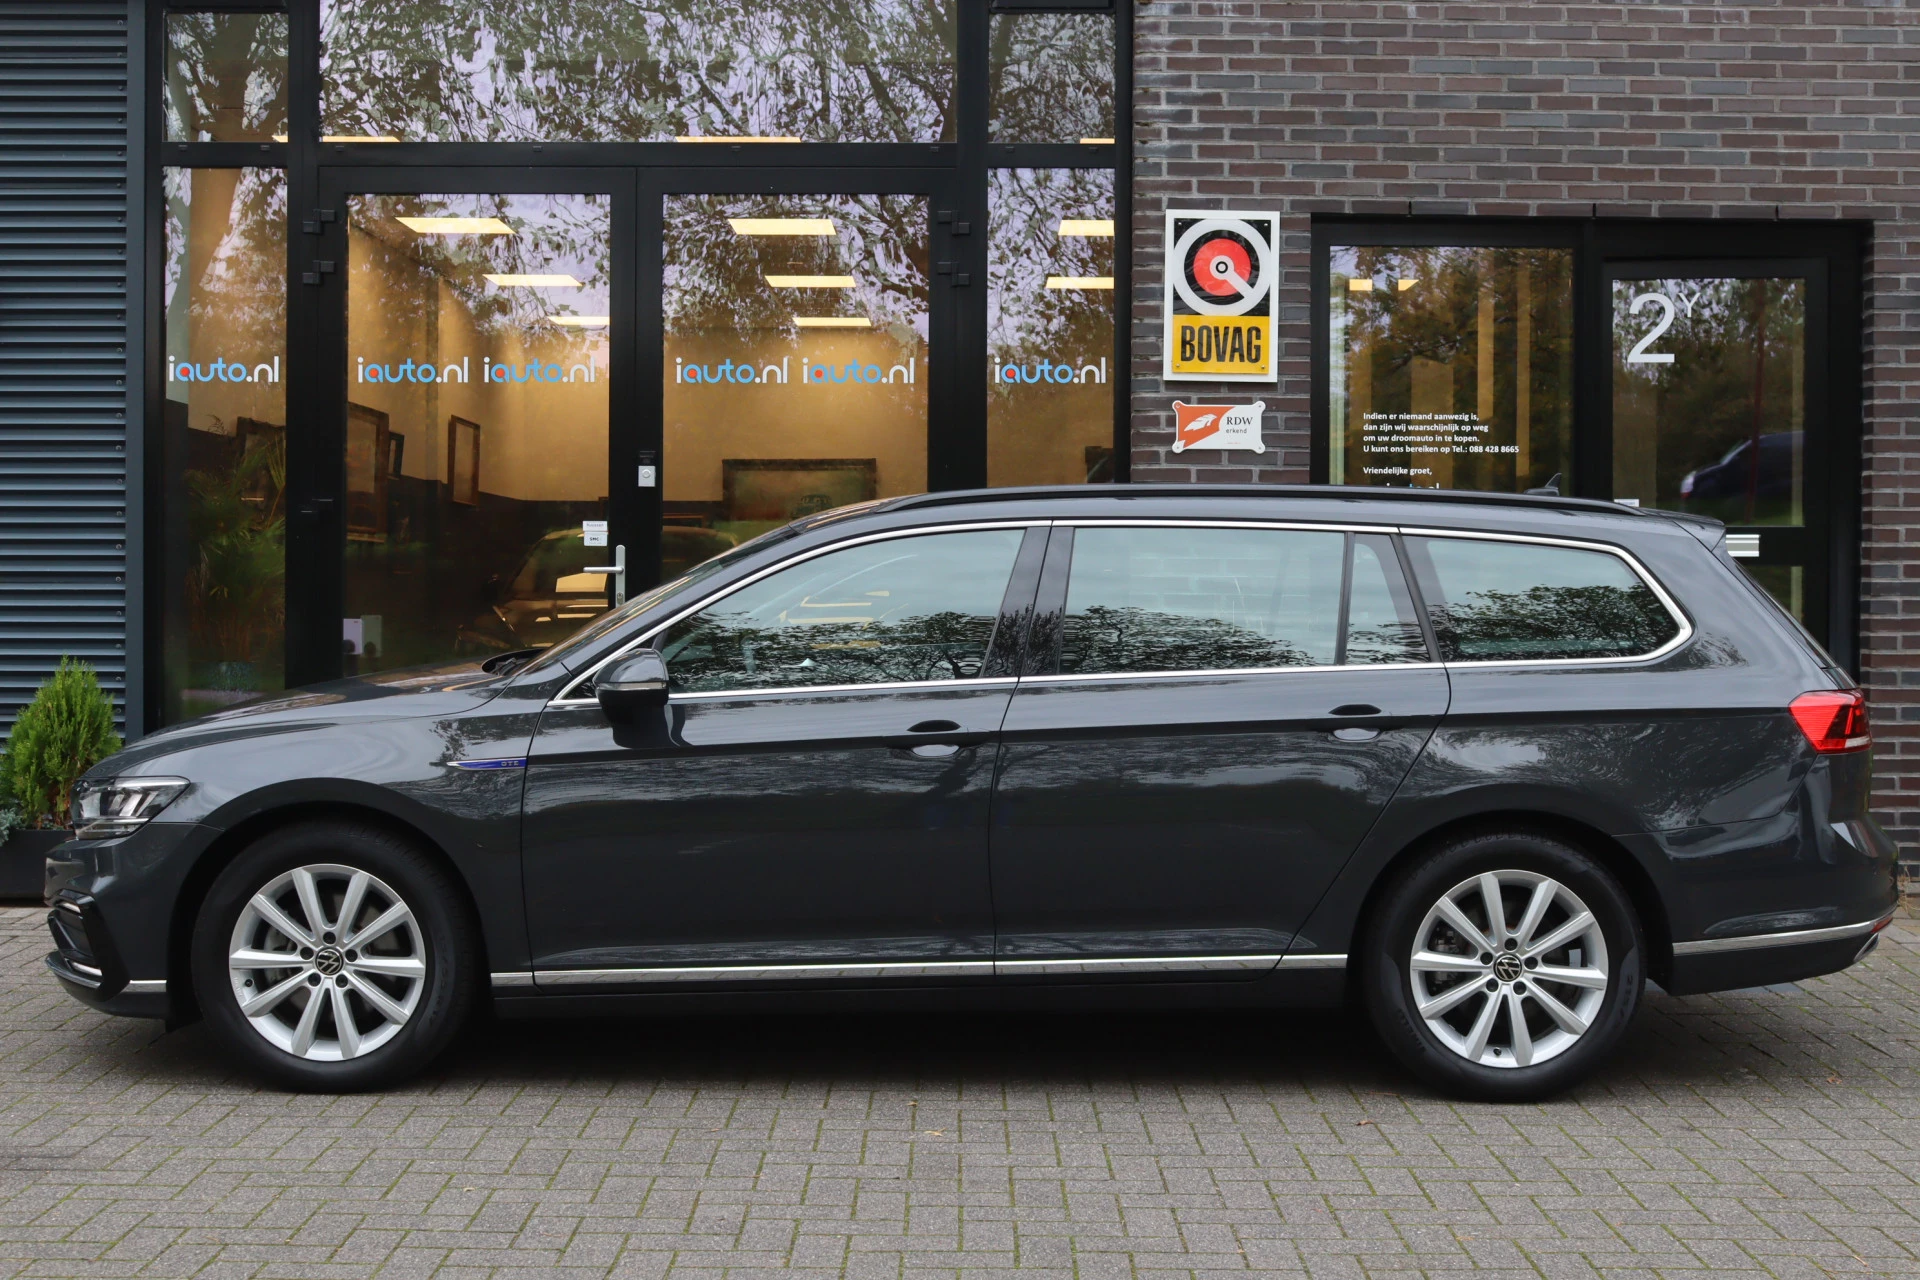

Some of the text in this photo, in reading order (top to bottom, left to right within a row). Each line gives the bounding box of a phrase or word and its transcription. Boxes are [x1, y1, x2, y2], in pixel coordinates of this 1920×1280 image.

[1180, 325, 1262, 363] BOVAG
[168, 355, 280, 383] iauto.nl
[357, 356, 596, 383] iauto.nl iauto.nl
[675, 357, 915, 384] iauto.nl iauto.nl
[994, 356, 1107, 384] iauto.nl
[1226, 416, 1253, 426] RDW
[1363, 412, 1388, 420] Indien
[1398, 412, 1433, 420] niemand
[1433, 412, 1470, 422] aanwezig
[1363, 423, 1378, 431] dan
[1379, 423, 1393, 433] zijn
[1394, 423, 1407, 433] wij
[1408, 423, 1460, 433] waarschijnlijk
[1391, 434, 1434, 442] droomauto
[1435, 434, 1443, 442] in
[1453, 434, 1480, 444] kopen.
[1363, 445, 1370, 453] U
[1371, 445, 1389, 453] kunt
[1405, 445, 1439, 453] bereiken
[1440, 446, 1451, 455] op
[1469, 445, 1484, 453] 088
[1485, 445, 1500, 453] 428
[1500, 445, 1520, 453] 8665
[1362, 466, 1433, 476] Vriendelijke groet,
